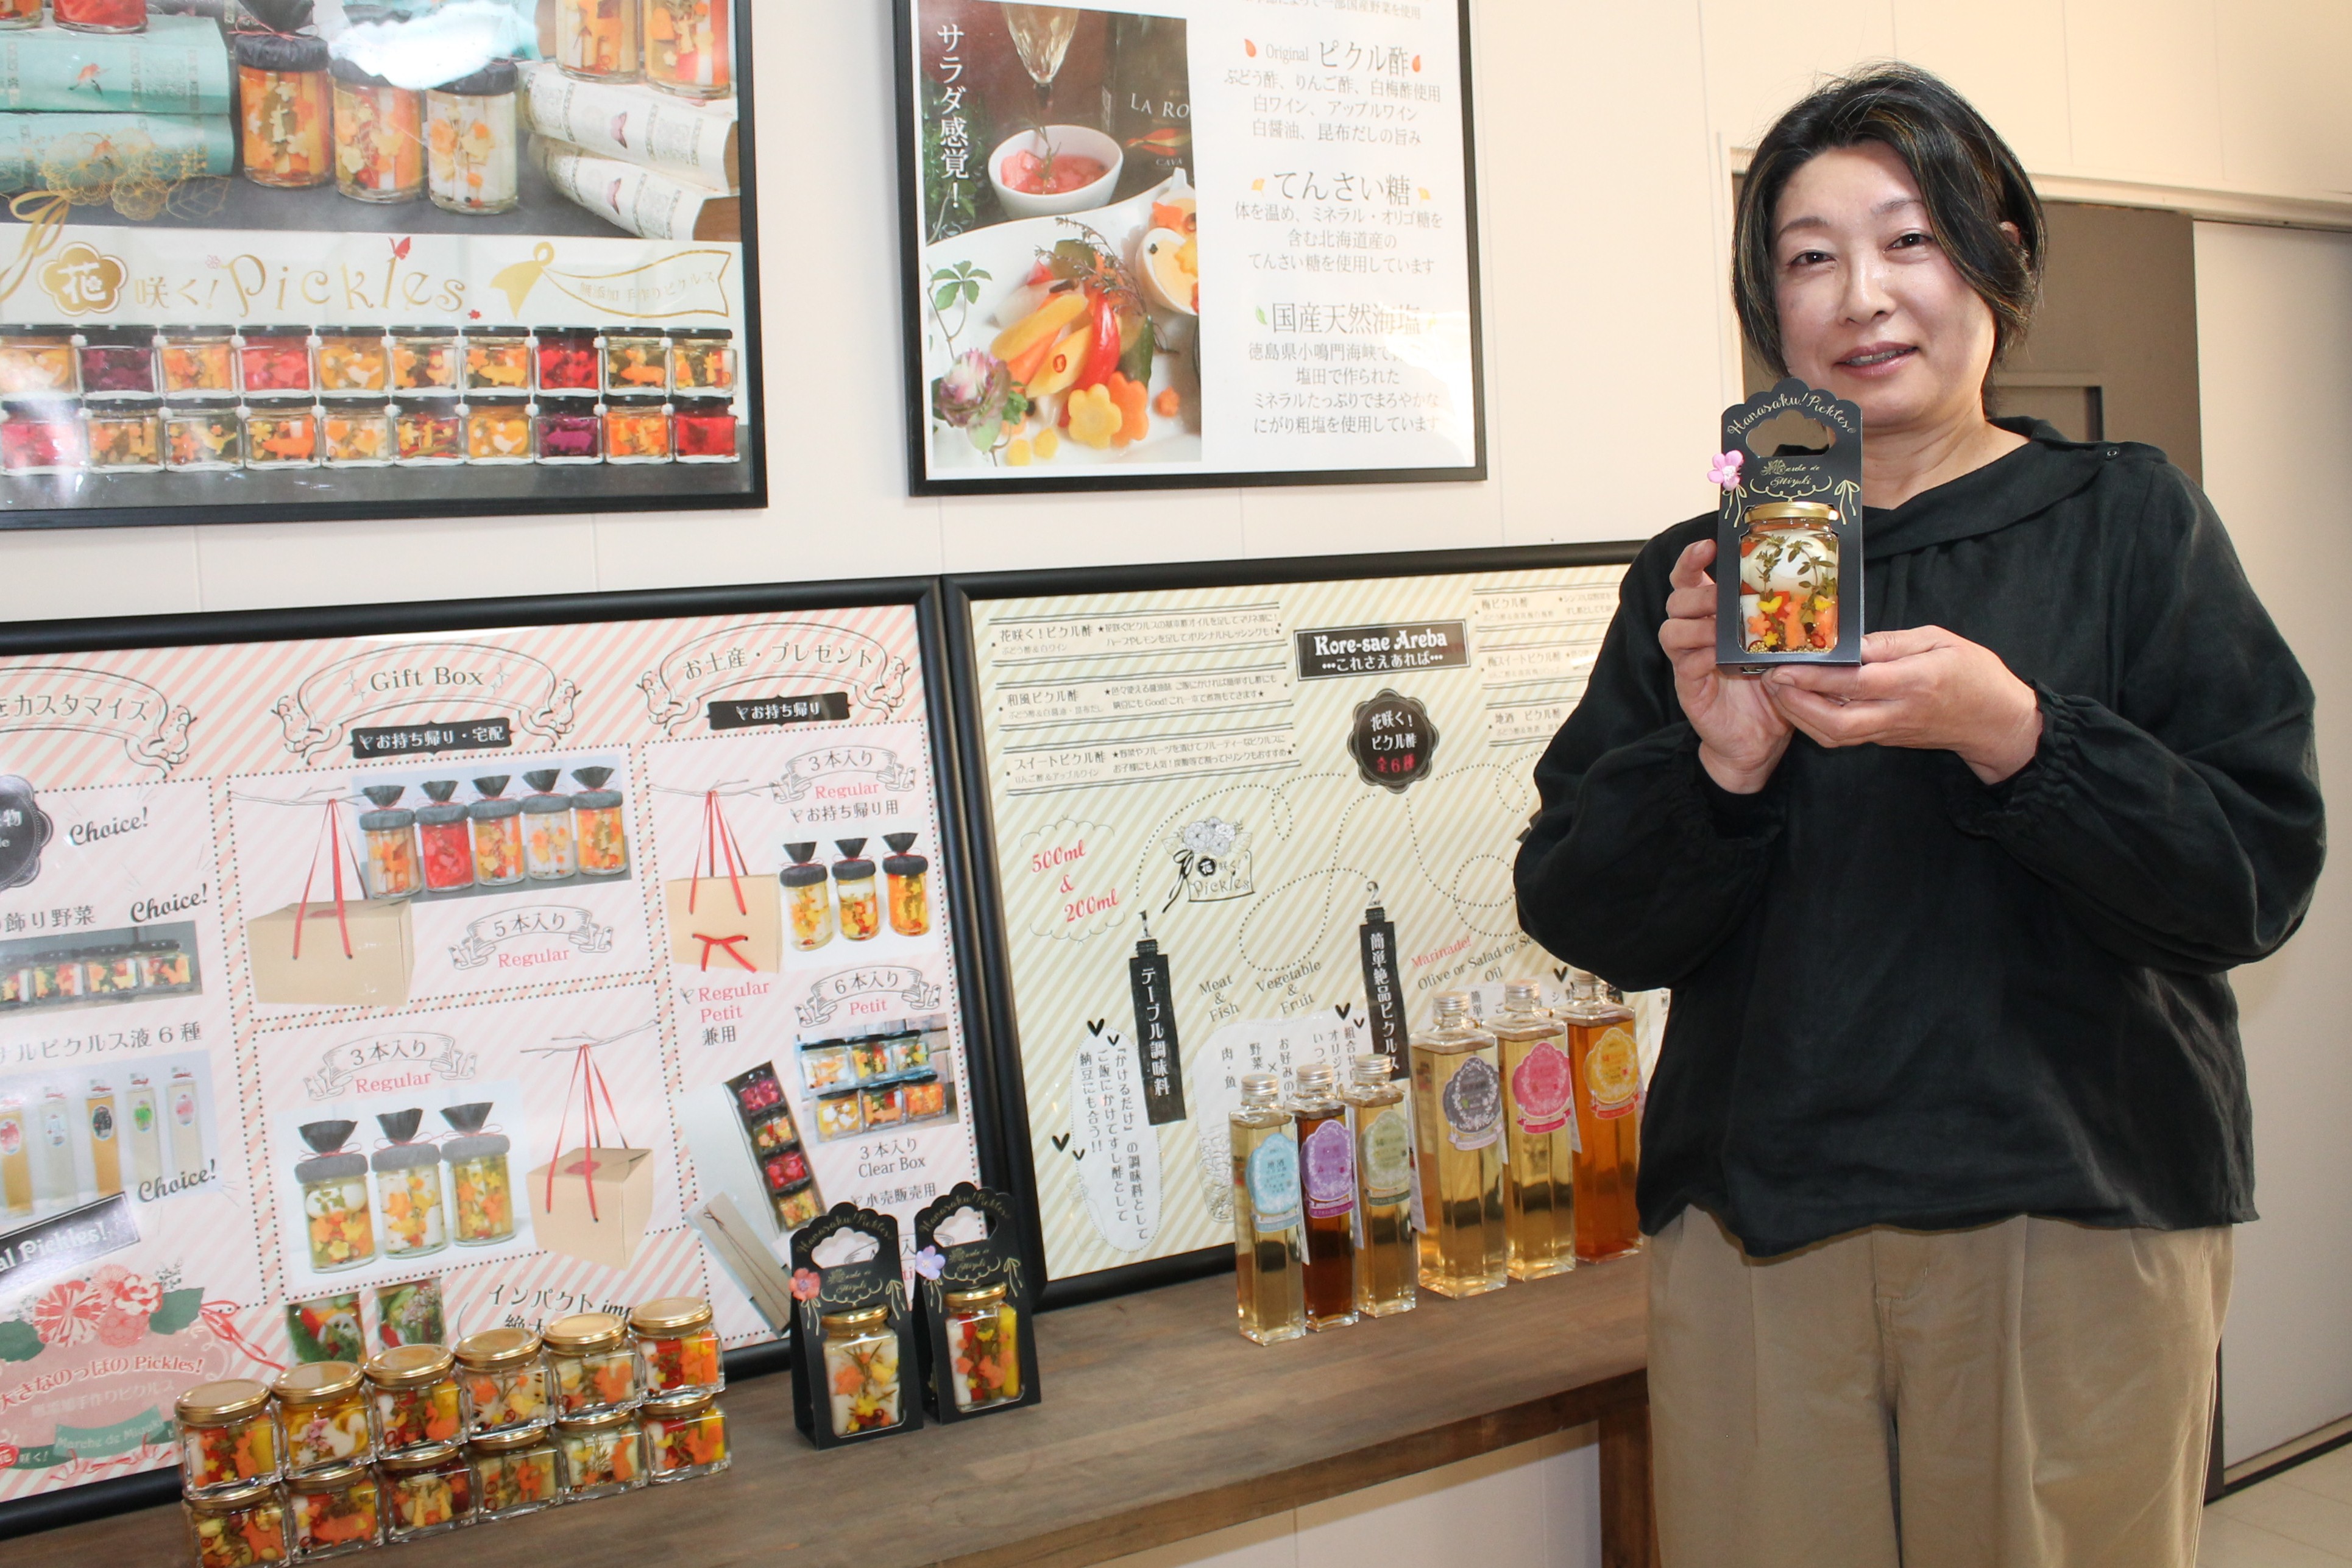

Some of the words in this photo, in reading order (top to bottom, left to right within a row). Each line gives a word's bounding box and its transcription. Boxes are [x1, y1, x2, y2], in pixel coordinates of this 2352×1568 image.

[1266, 43, 1308, 65] Original
[1319, 40, 1409, 77] ピクル酢
[937, 23, 970, 208] サラダ感覚!
[1130, 93, 1152, 115] LA
[1155, 157, 1183, 168] CAVA
[1273, 171, 1411, 207] てんさい糖
[1288, 228, 1398, 250] 含む北海道産の
[1249, 253, 1435, 275] てんさい糖を使用しています
[58, 258, 115, 300] 花
[218, 253, 467, 317] Pickles
[1295, 367, 1400, 386] 塩田で作られた
[1253, 415, 1439, 435] にがり粗塩を使用しています
[1769, 475, 1812, 488] Miyuki
[1314, 635, 1390, 657] Kore-sae
[1394, 628, 1448, 651] Areba
[682, 641, 873, 680] お土産・プレゼント
[370, 668, 423, 692] Gift
[433, 666, 485, 687] Box
[750, 701, 821, 721] お持ち帰り
[375, 726, 506, 751] お持ち帰り・宅配
[814, 781, 879, 801] Regular
[806, 799, 899, 823] お持ち帰り用
[69, 806, 149, 847] Choice!
[1031, 838, 1086, 874] 500ml
[1059, 874, 1074, 894] &
[1189, 871, 1250, 898] Pickles
[129, 882, 208, 924] Choice!
[1064, 888, 1119, 923] 200ml
[0, 904, 96, 933] 飾り野菜
[497, 948, 570, 970] Regular
[1411, 935, 1473, 969] Marinade!
[1256, 959, 1322, 994] Vegetable
[1417, 970, 1451, 991] Olive
[1454, 964, 1465, 976] or
[1468, 947, 1502, 969] Salad
[1504, 944, 1517, 955] or
[1484, 966, 1503, 983] Oil
[696, 981, 770, 1003] Regular
[1198, 974, 1233, 996] Meat
[1287, 983, 1298, 997] &
[849, 1000, 888, 1016] Petit
[1214, 992, 1226, 1005] &
[1280, 992, 1315, 1015] Fruit
[700, 1004, 743, 1023] Petit
[1209, 1003, 1240, 1022] Fish
[701, 1025, 737, 1047] 兼用
[1141, 967, 1171, 1097] テーブル調味料
[1249, 1042, 1263, 1070] 野菜
[1221, 1047, 1237, 1090] 肉・魚
[355, 1071, 431, 1095] Regular
[858, 1160, 894, 1179] Clear
[900, 1155, 926, 1172] Box
[138, 1158, 216, 1203] Choice!
[864, 1182, 937, 1207] 小売販売用
[489, 1284, 593, 1313] インパクト
[133, 1355, 204, 1374] Pickles!
